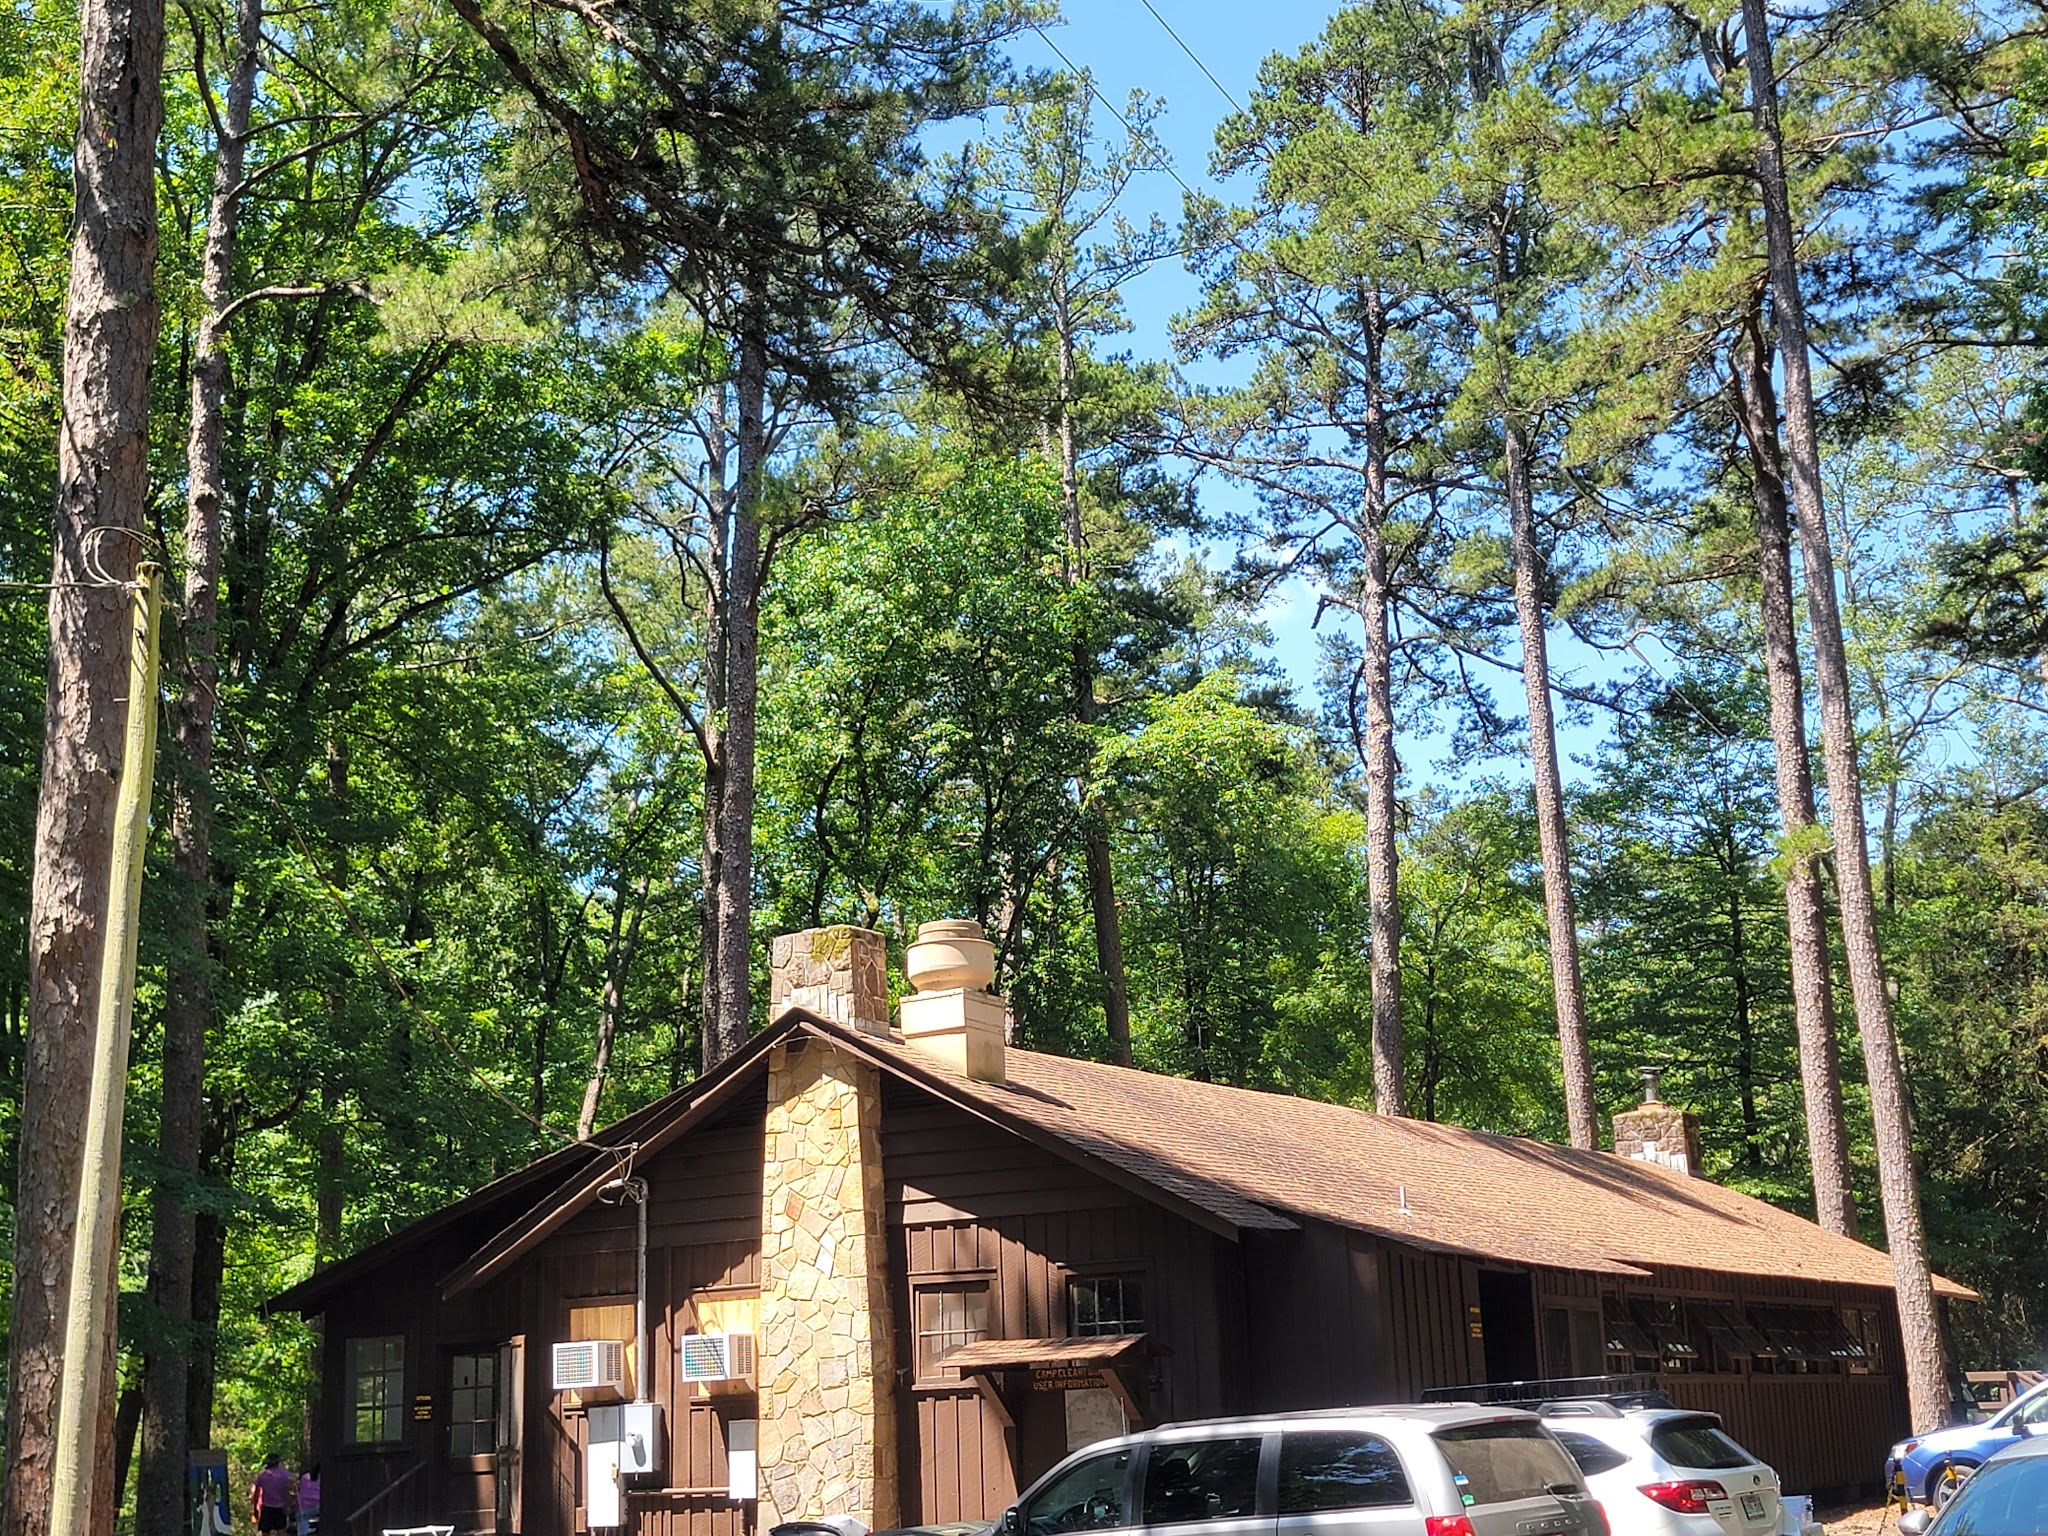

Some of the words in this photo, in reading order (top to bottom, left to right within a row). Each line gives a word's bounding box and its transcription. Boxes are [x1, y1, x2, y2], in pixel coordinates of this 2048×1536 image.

[1035, 1368, 1057, 1379] CAMP
[1033, 1379, 1053, 1390] USER
[1054, 1378, 1106, 1389] INFORMATION
